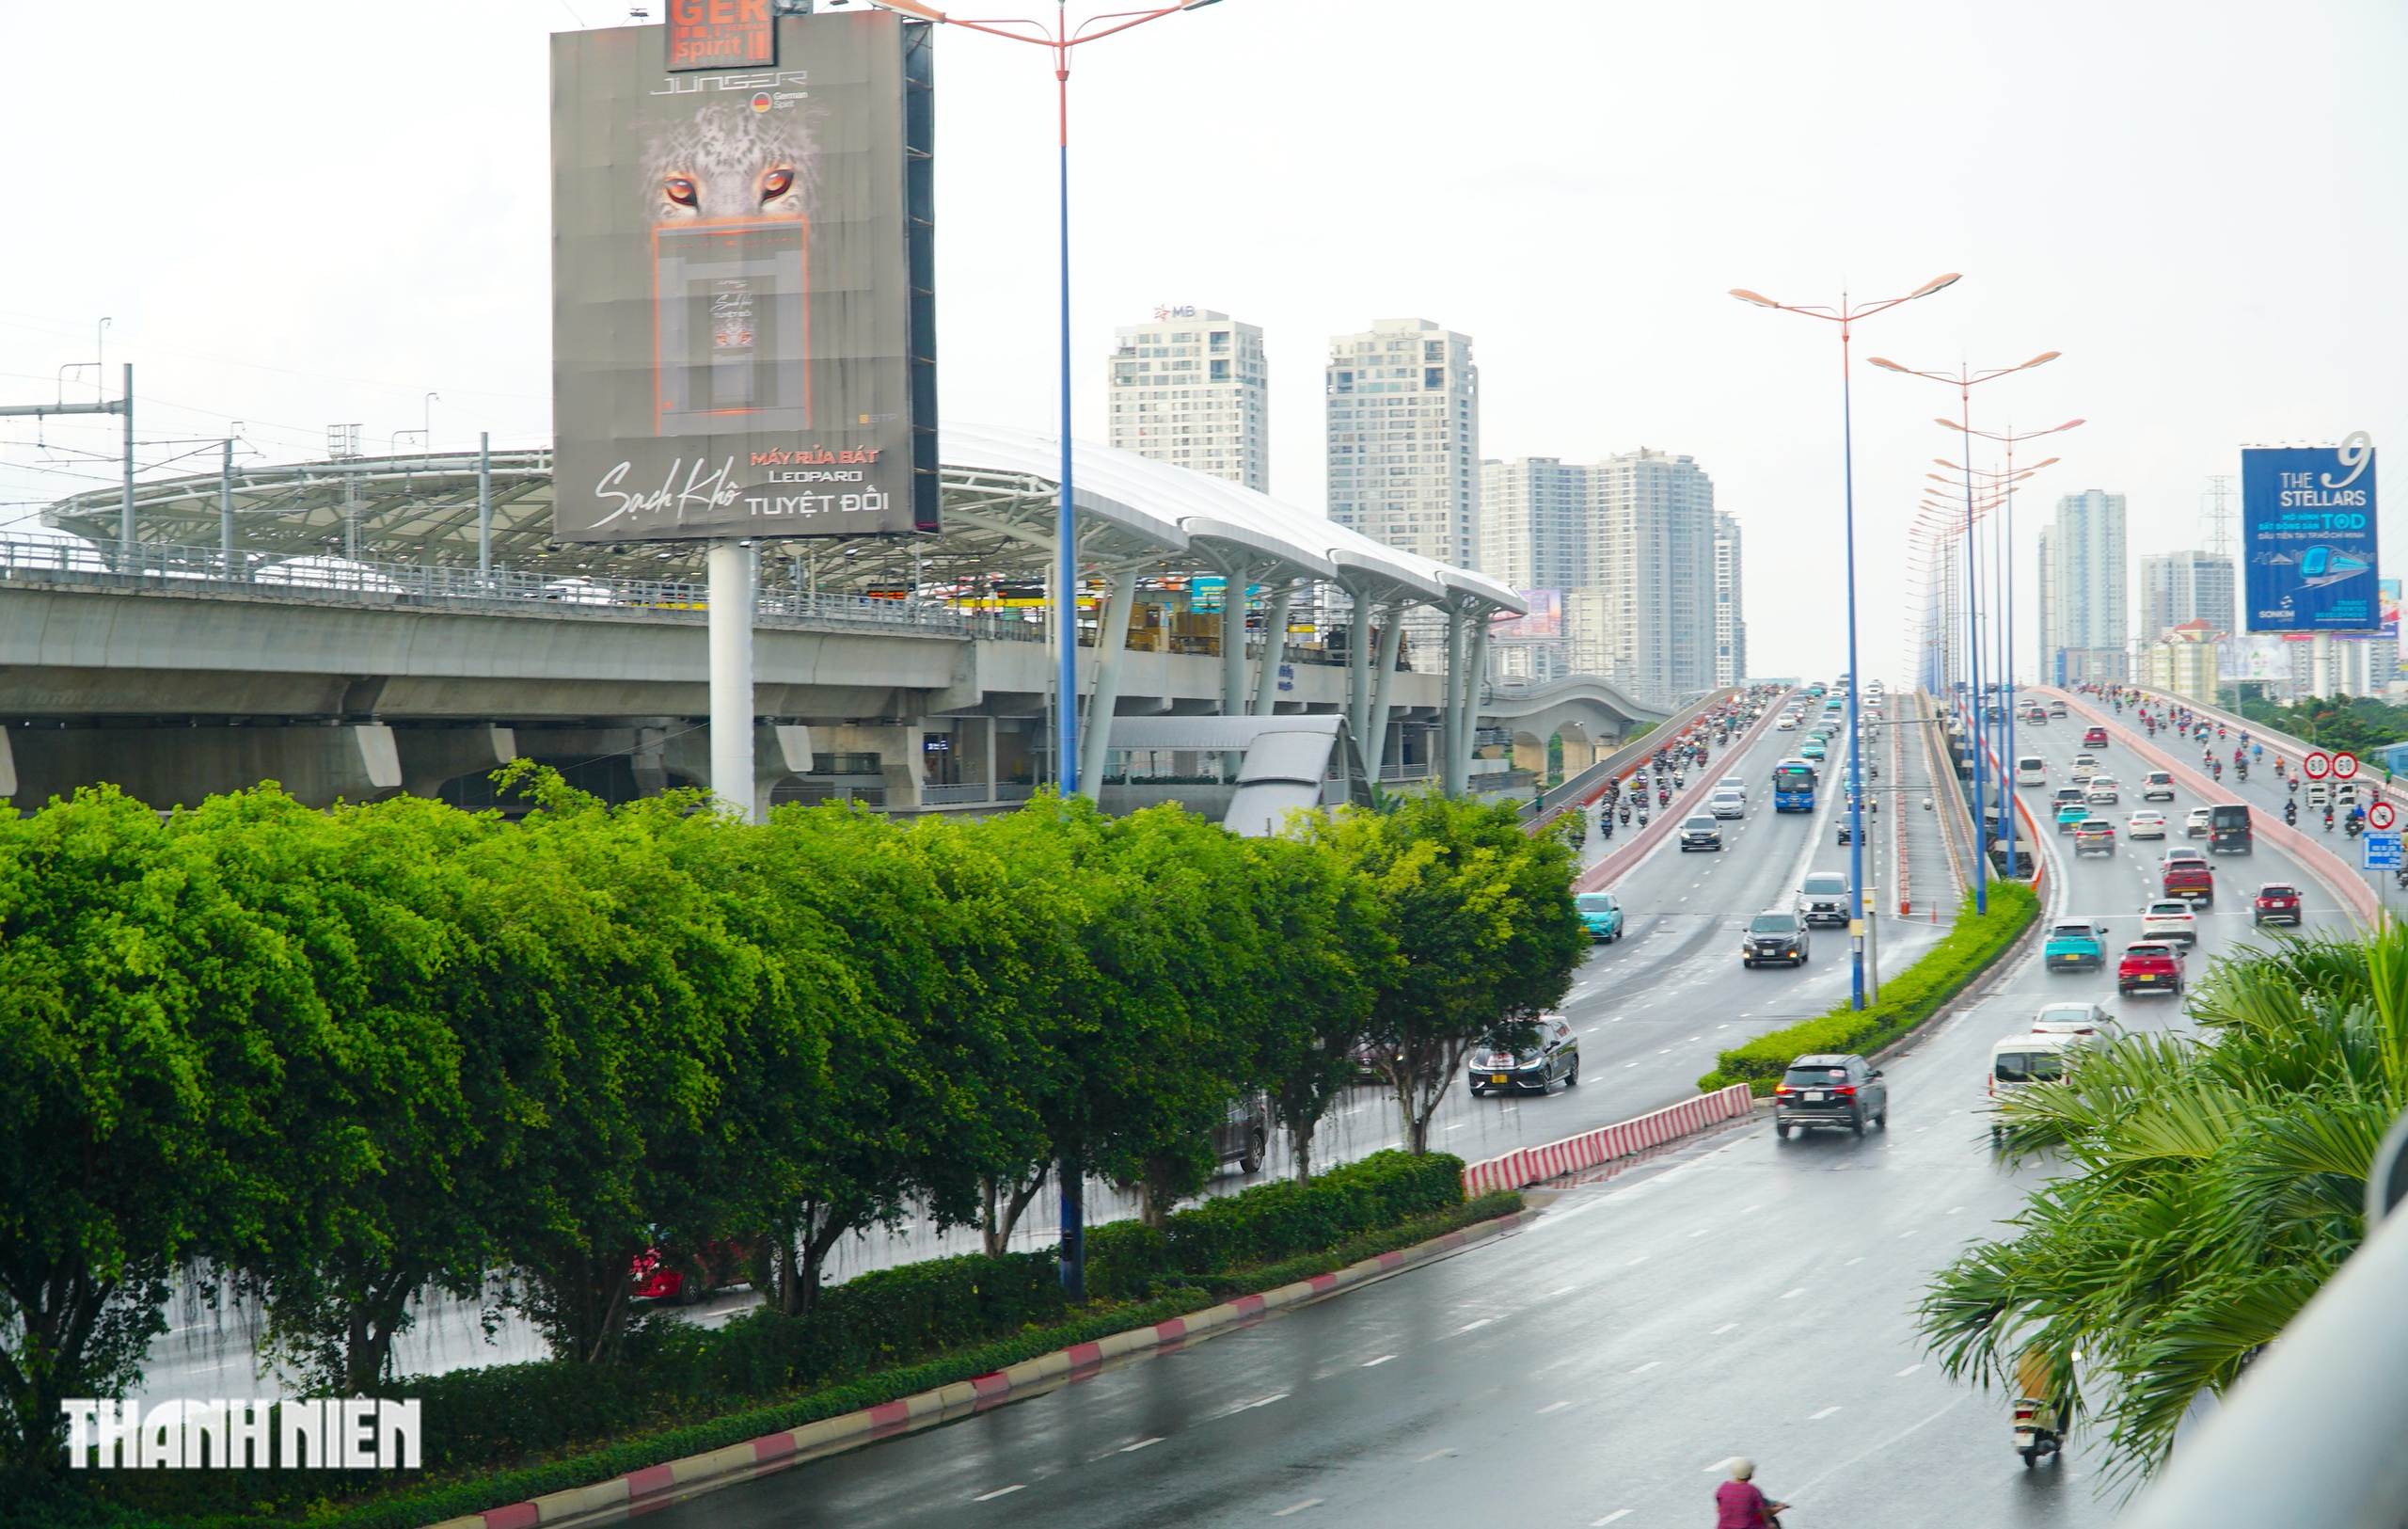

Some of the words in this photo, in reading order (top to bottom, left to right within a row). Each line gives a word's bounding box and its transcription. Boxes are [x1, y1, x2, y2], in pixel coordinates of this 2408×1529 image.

[773, 91, 808, 101] German
[1172, 305, 1195, 318] MB
[751, 447, 793, 466] MÁY
[838, 445, 880, 464] BÁT
[2279, 472, 2313, 488] THE
[2321, 430, 2372, 488] 9
[768, 470, 863, 484] LEOPARD
[585, 459, 681, 530] Sạch
[676, 455, 743, 518] Khô
[2280, 490, 2367, 506] STELLARS
[743, 490, 836, 518] TUYỆT
[840, 485, 889, 512] ĐỐI
[2321, 513, 2367, 530] TOD
[2310, 758, 2324, 772] 80
[2338, 758, 2353, 772] 60
